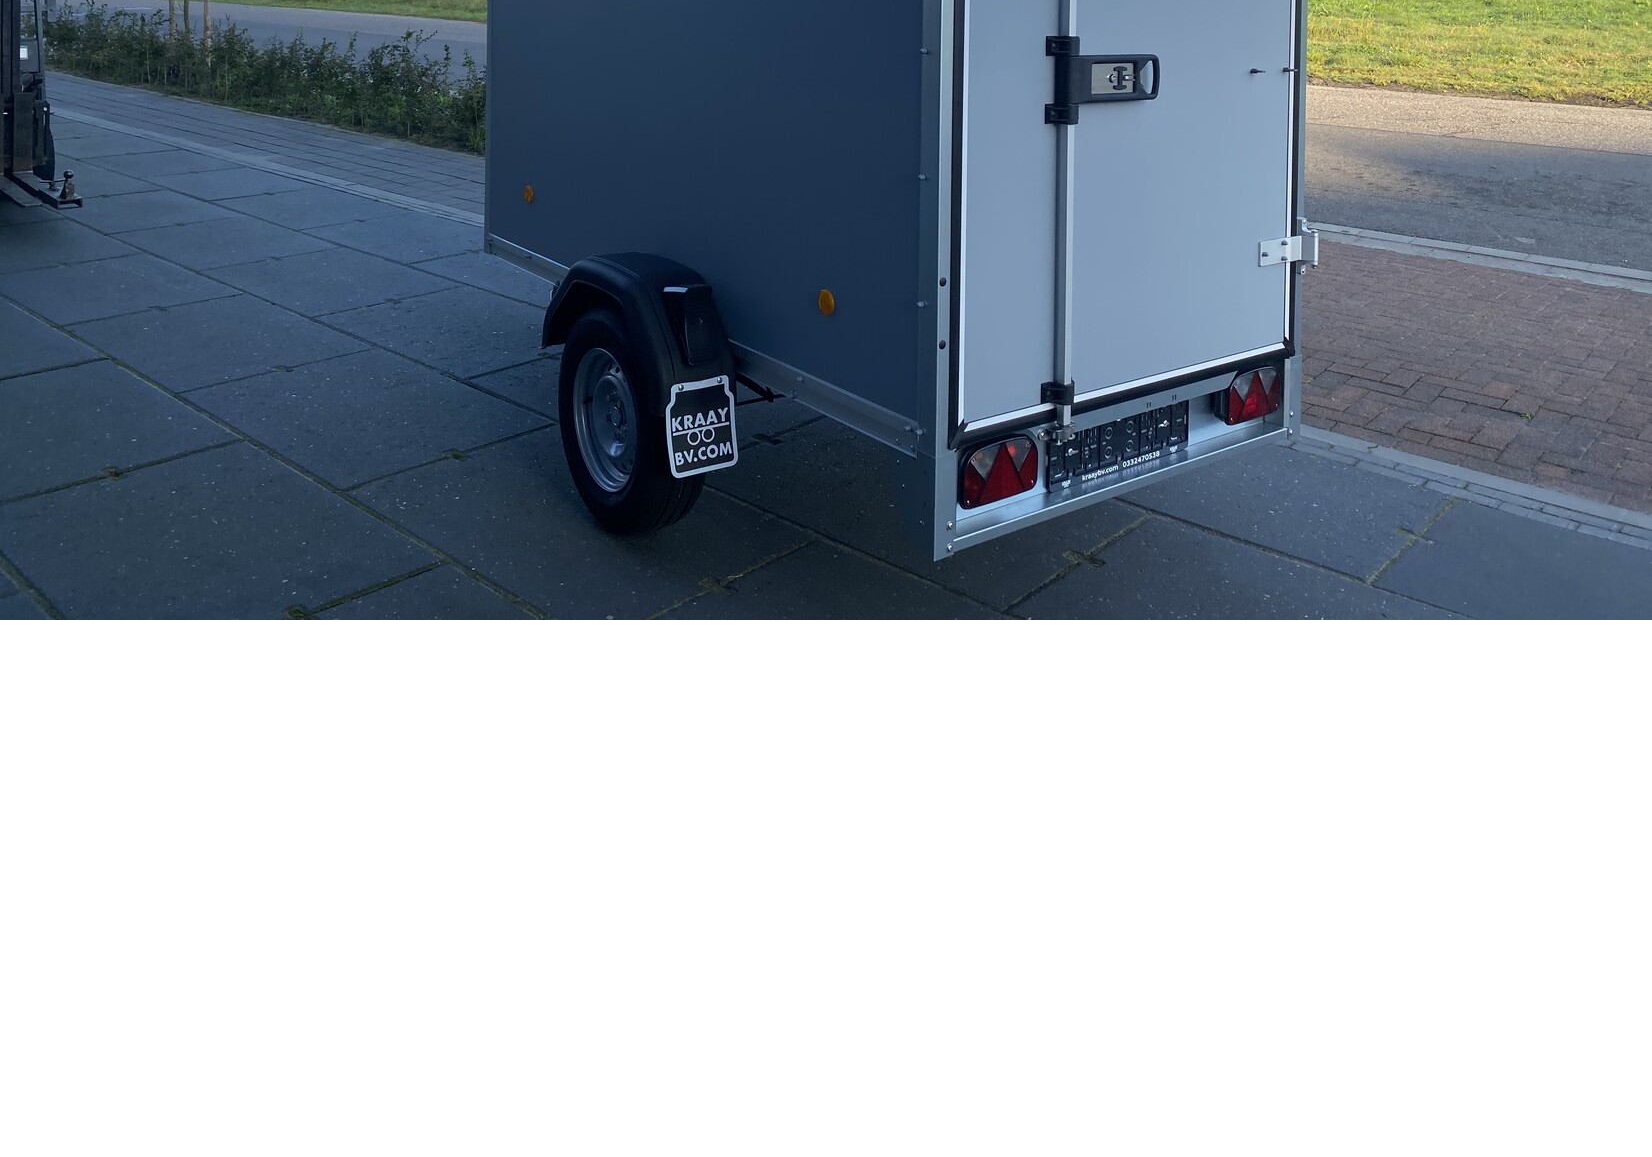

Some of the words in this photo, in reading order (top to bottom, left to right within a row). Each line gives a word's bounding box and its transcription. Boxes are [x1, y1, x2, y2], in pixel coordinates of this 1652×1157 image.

[671, 407, 728, 432] KRAAY
[674, 441, 732, 466] BV.COM
[1081, 465, 1119, 481] kraaybv.com
[1122, 450, 1160, 468] 0332470538
